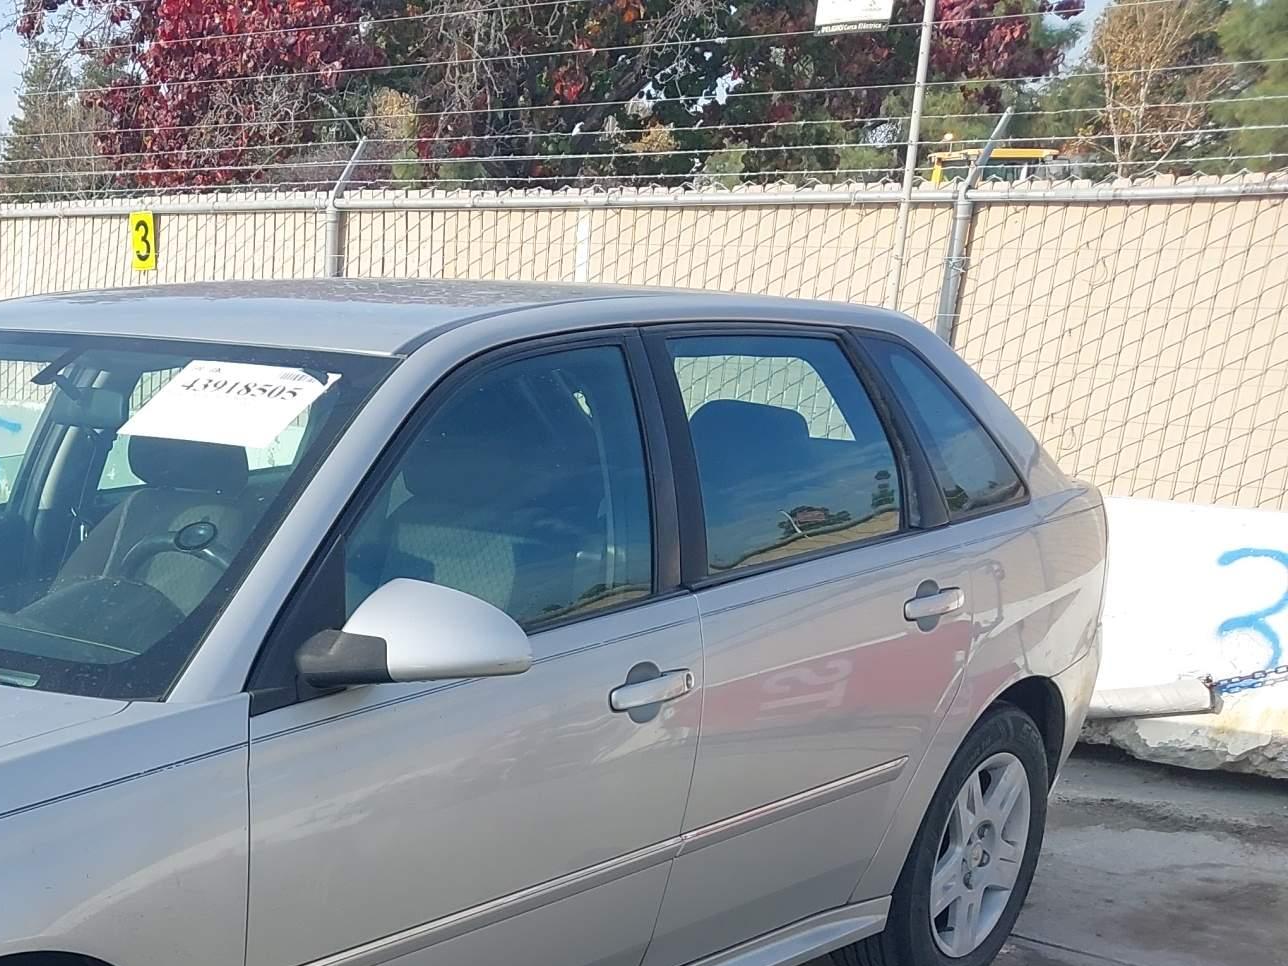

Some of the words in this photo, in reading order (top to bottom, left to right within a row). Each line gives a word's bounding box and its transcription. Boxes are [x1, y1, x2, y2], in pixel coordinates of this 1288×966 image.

[135, 219, 151, 262] 3
[181, 378, 304, 400] 43918505
[1217, 547, 1288, 671] 3
